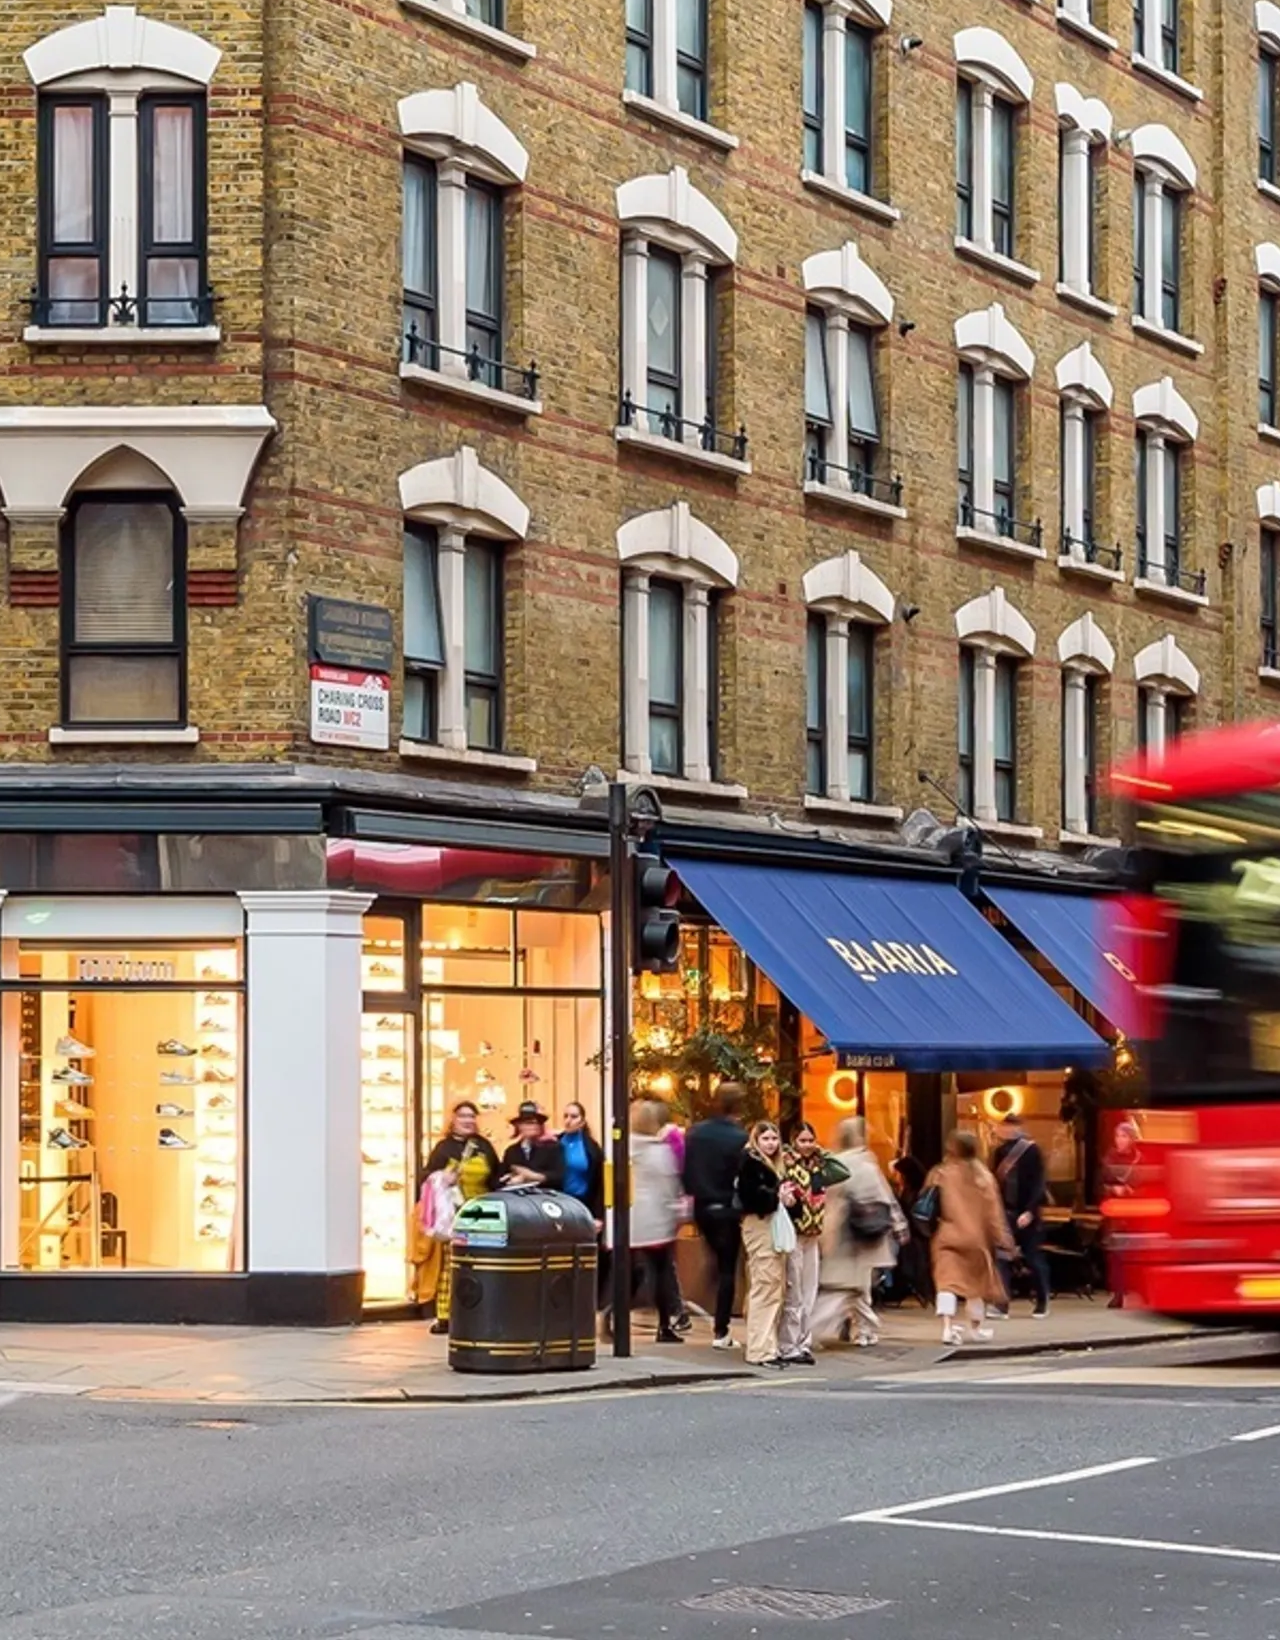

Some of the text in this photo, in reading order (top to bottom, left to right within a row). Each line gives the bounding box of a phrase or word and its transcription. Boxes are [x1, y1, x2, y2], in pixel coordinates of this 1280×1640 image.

[317, 687, 384, 712] CHARING CROSS
[317, 706, 362, 727] ROAD WC2
[825, 937, 959, 981] BAARIA
